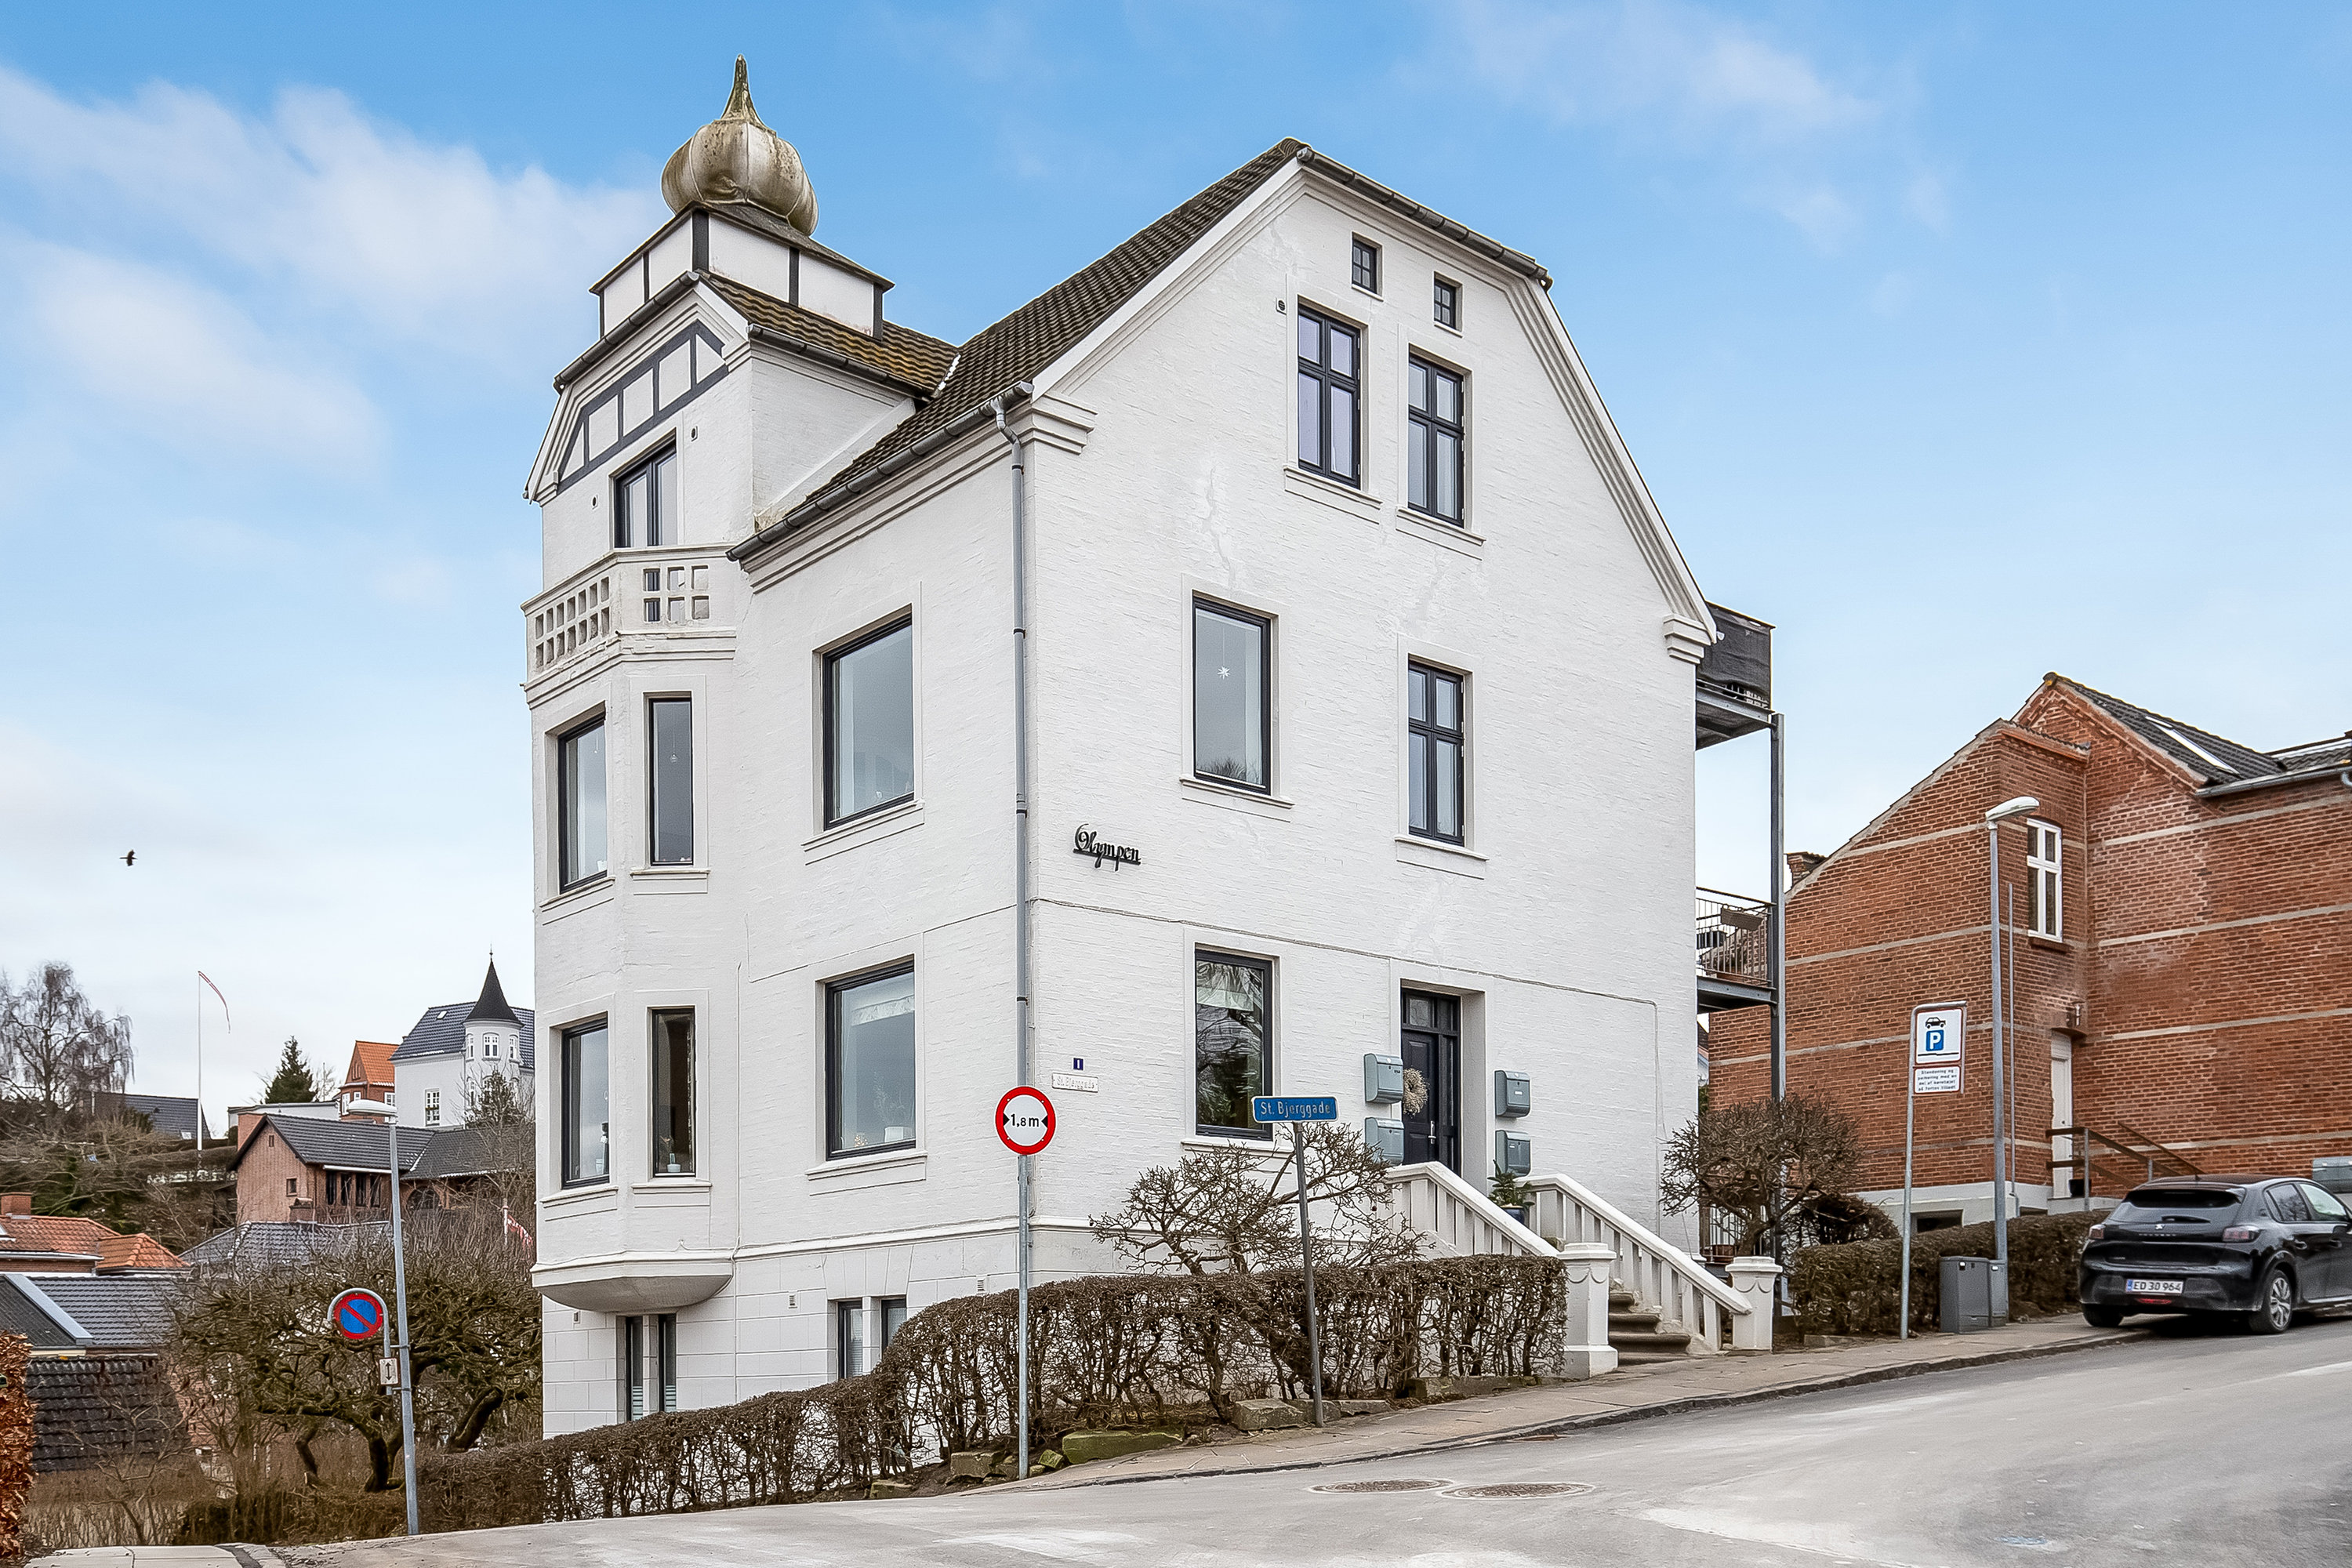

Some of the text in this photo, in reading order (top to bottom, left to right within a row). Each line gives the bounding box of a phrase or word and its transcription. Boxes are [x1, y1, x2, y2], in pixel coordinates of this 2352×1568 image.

[1074, 823, 1142, 872] Olympen
[1929, 1032, 1941, 1050] P
[1261, 1101, 1330, 1118] St. Bjerggade
[1011, 1113, 1039, 1127] 1,8 m
[2148, 1282, 2161, 1290] 30
[2163, 1283, 2182, 1291] 964
